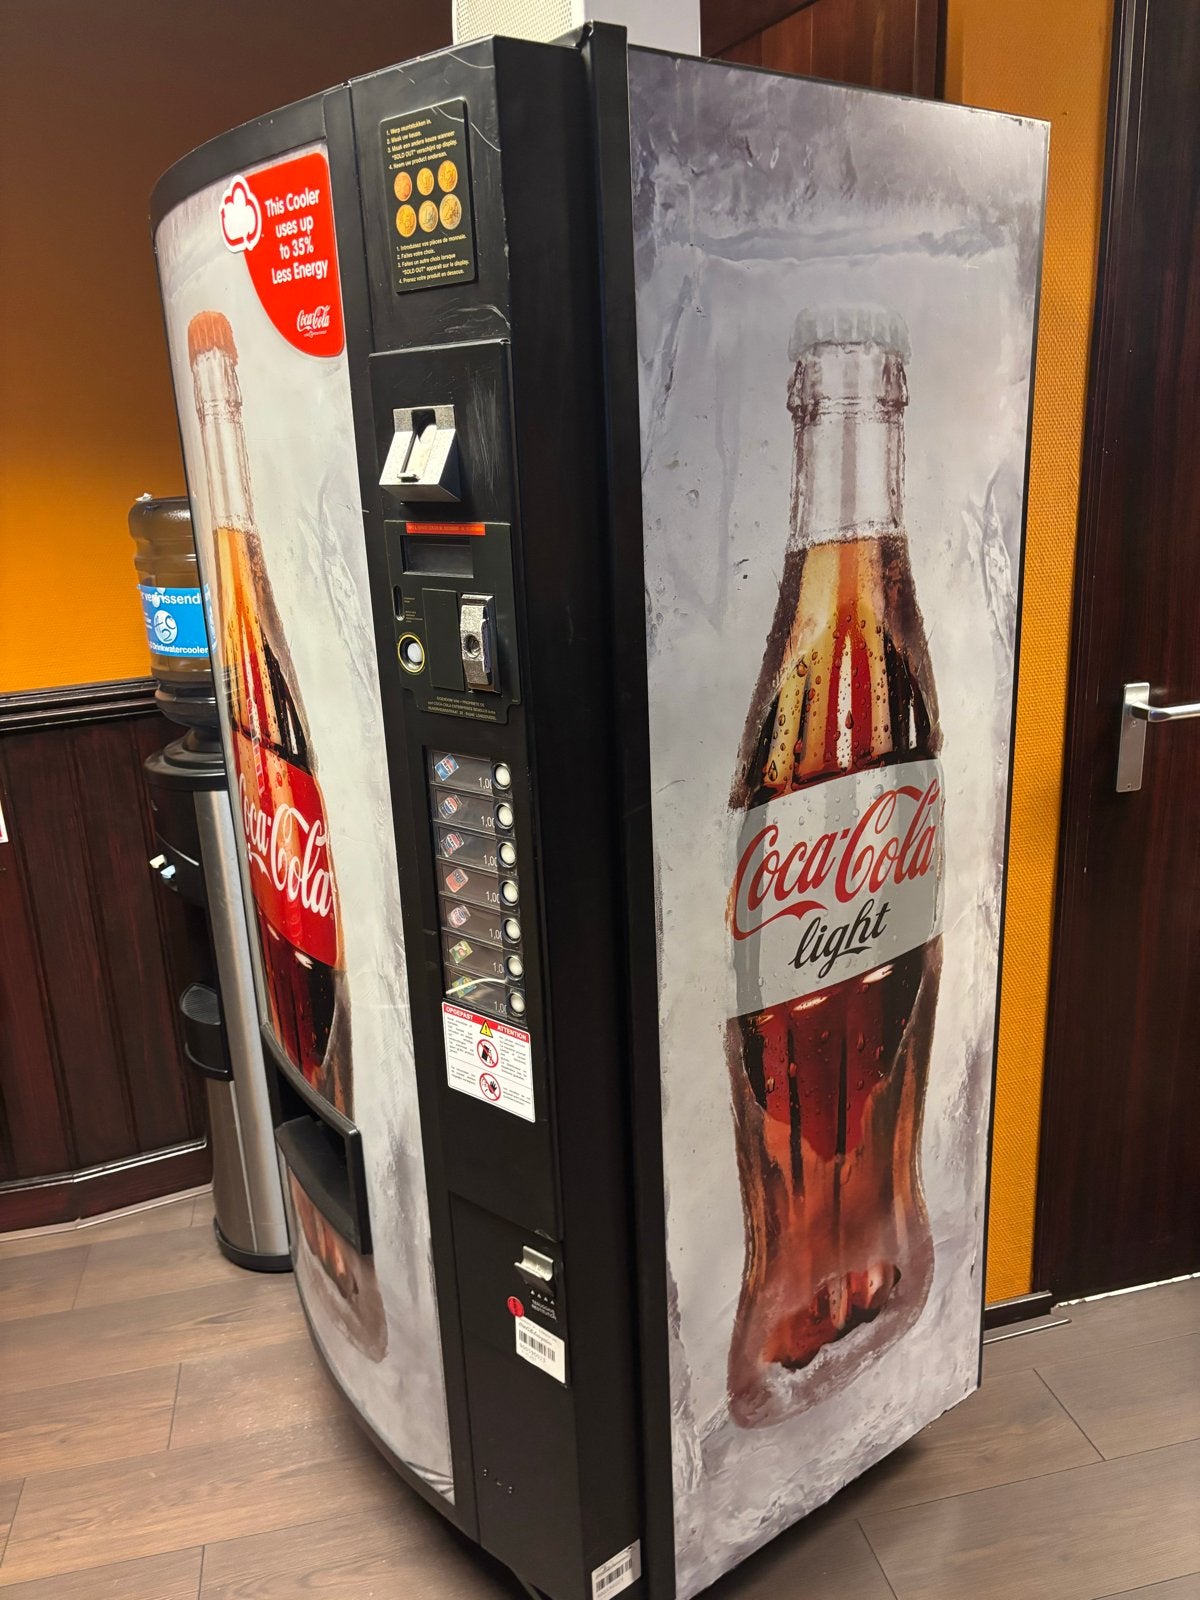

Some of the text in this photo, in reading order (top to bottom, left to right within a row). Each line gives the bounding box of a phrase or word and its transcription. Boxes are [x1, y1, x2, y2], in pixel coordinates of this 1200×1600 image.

[265, 187, 320, 218] This Cooler
[275, 216, 314, 238] uses up
[280, 236, 314, 260] to 35%
[271, 260, 328, 284] Less Energy
[297, 305, 330, 332] Coca-Cola
[732, 778, 940, 940] Coca-Cola
[788, 899, 891, 978] light
[446, 1006, 527, 1041] OPGEPAST ATTENTION
